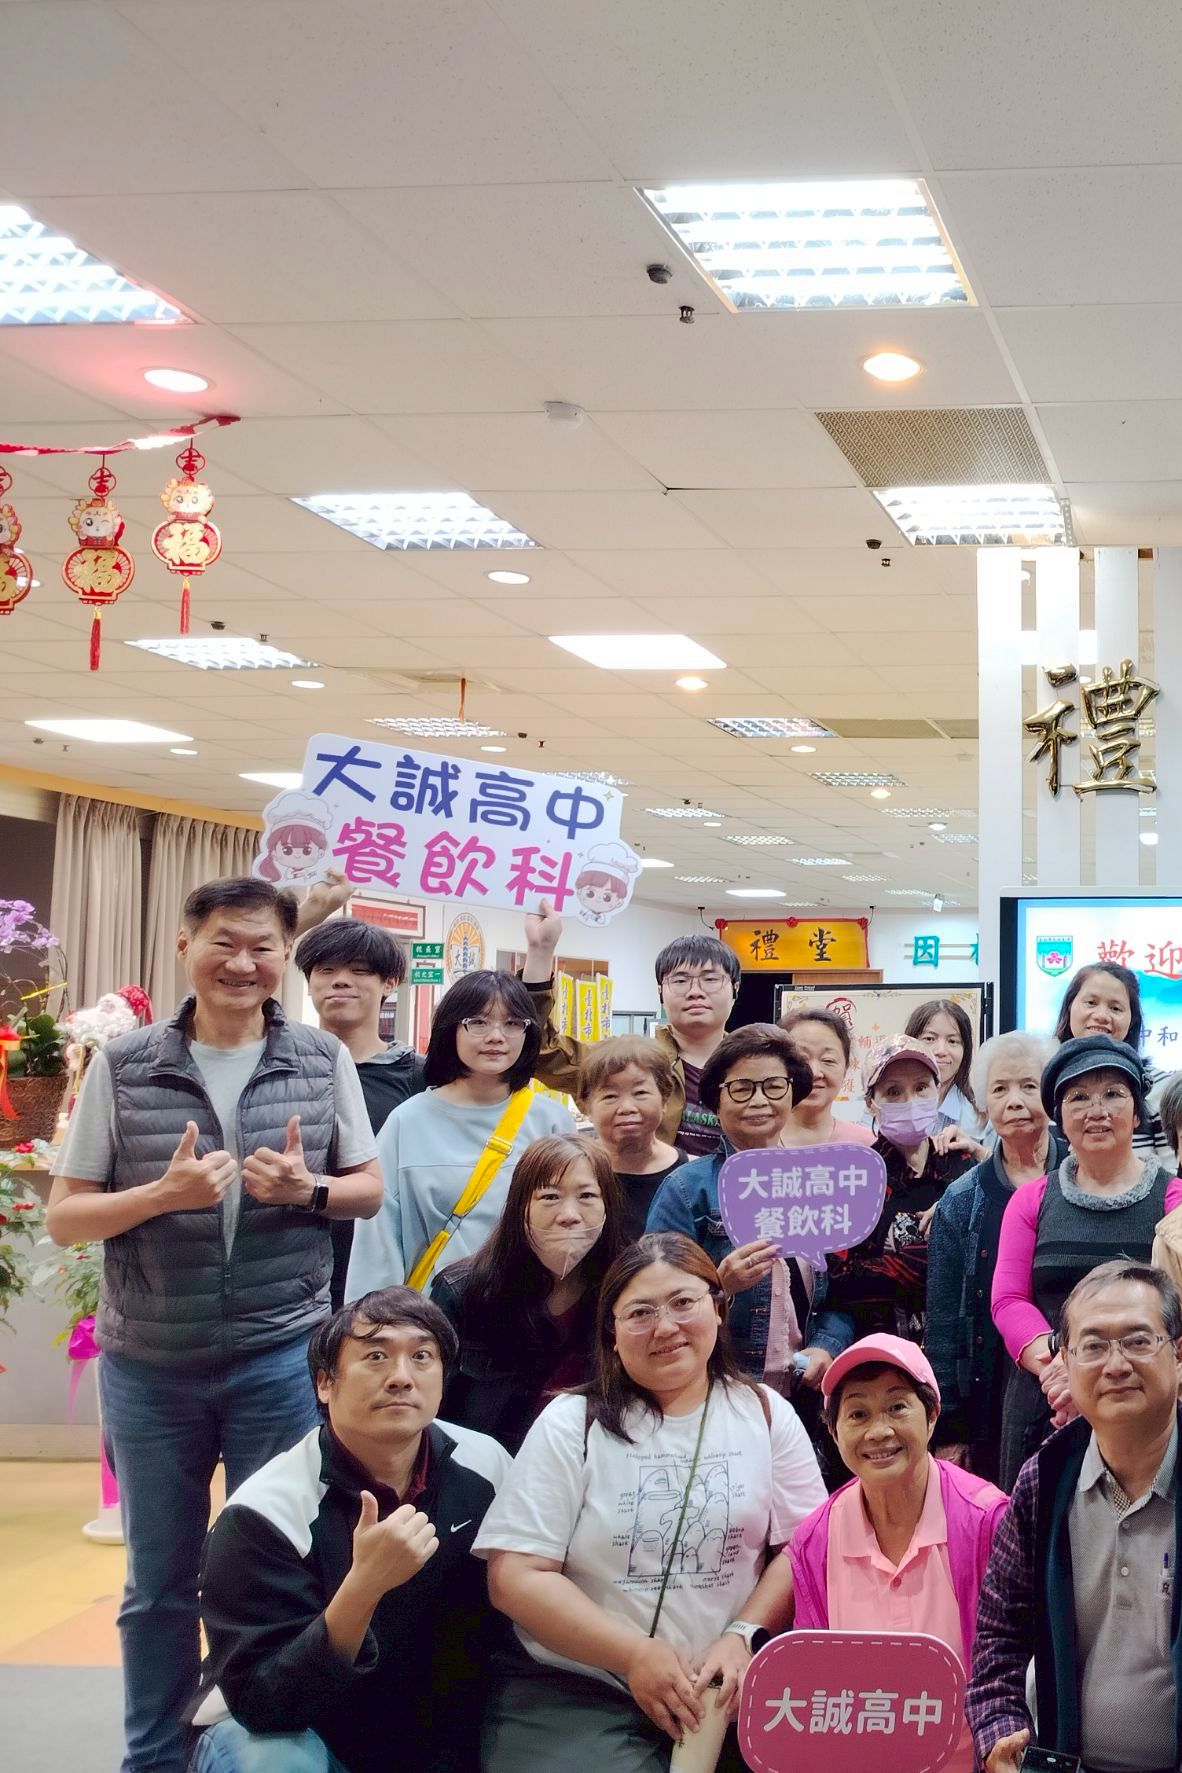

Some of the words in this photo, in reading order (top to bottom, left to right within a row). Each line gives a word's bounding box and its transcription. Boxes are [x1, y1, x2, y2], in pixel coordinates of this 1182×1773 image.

[163, 522, 210, 565] 福
[75, 549, 118, 594] 福
[313, 745, 606, 840] 大誠高中
[332, 816, 576, 913] 餐飲科
[750, 927, 837, 963] 禮堂
[738, 1164, 868, 1200] 大誠高中
[754, 1204, 852, 1240] 餐飲科
[763, 1687, 943, 1737] 大誠高中
